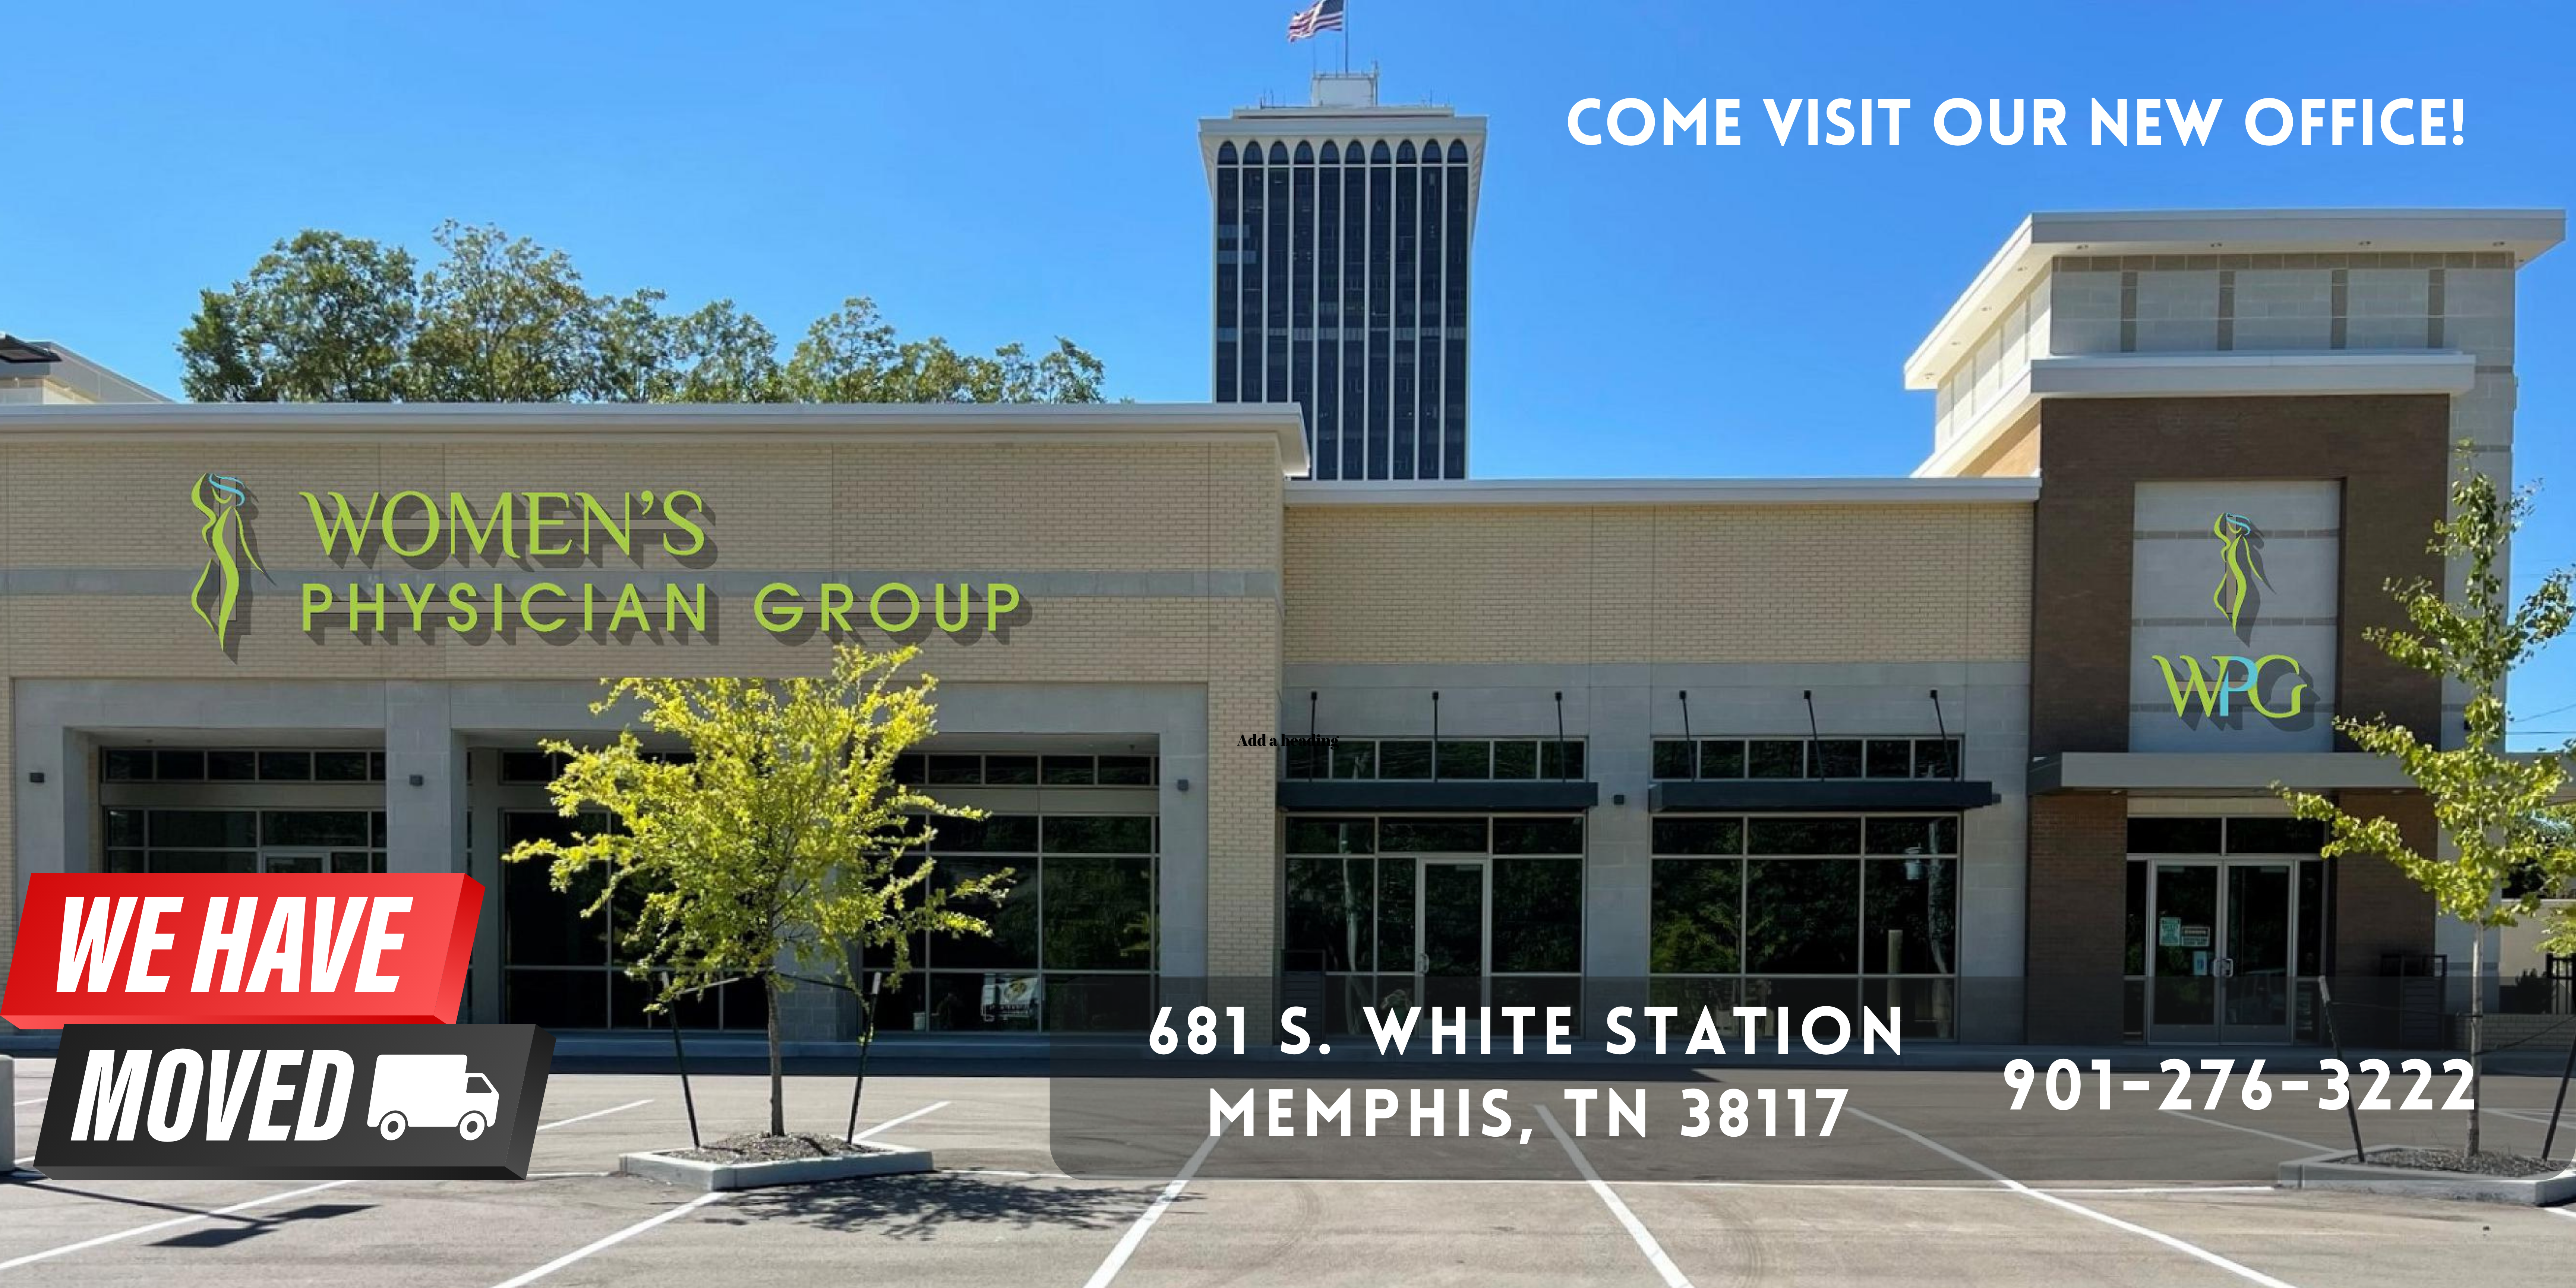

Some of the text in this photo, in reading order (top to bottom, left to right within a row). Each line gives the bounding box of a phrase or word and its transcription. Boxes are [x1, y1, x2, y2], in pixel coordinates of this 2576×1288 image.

[299, 490, 704, 558] WOMEN'S
[302, 583, 1019, 632] PHYSICIAN GROUP
[2152, 654, 2307, 718] WPG
